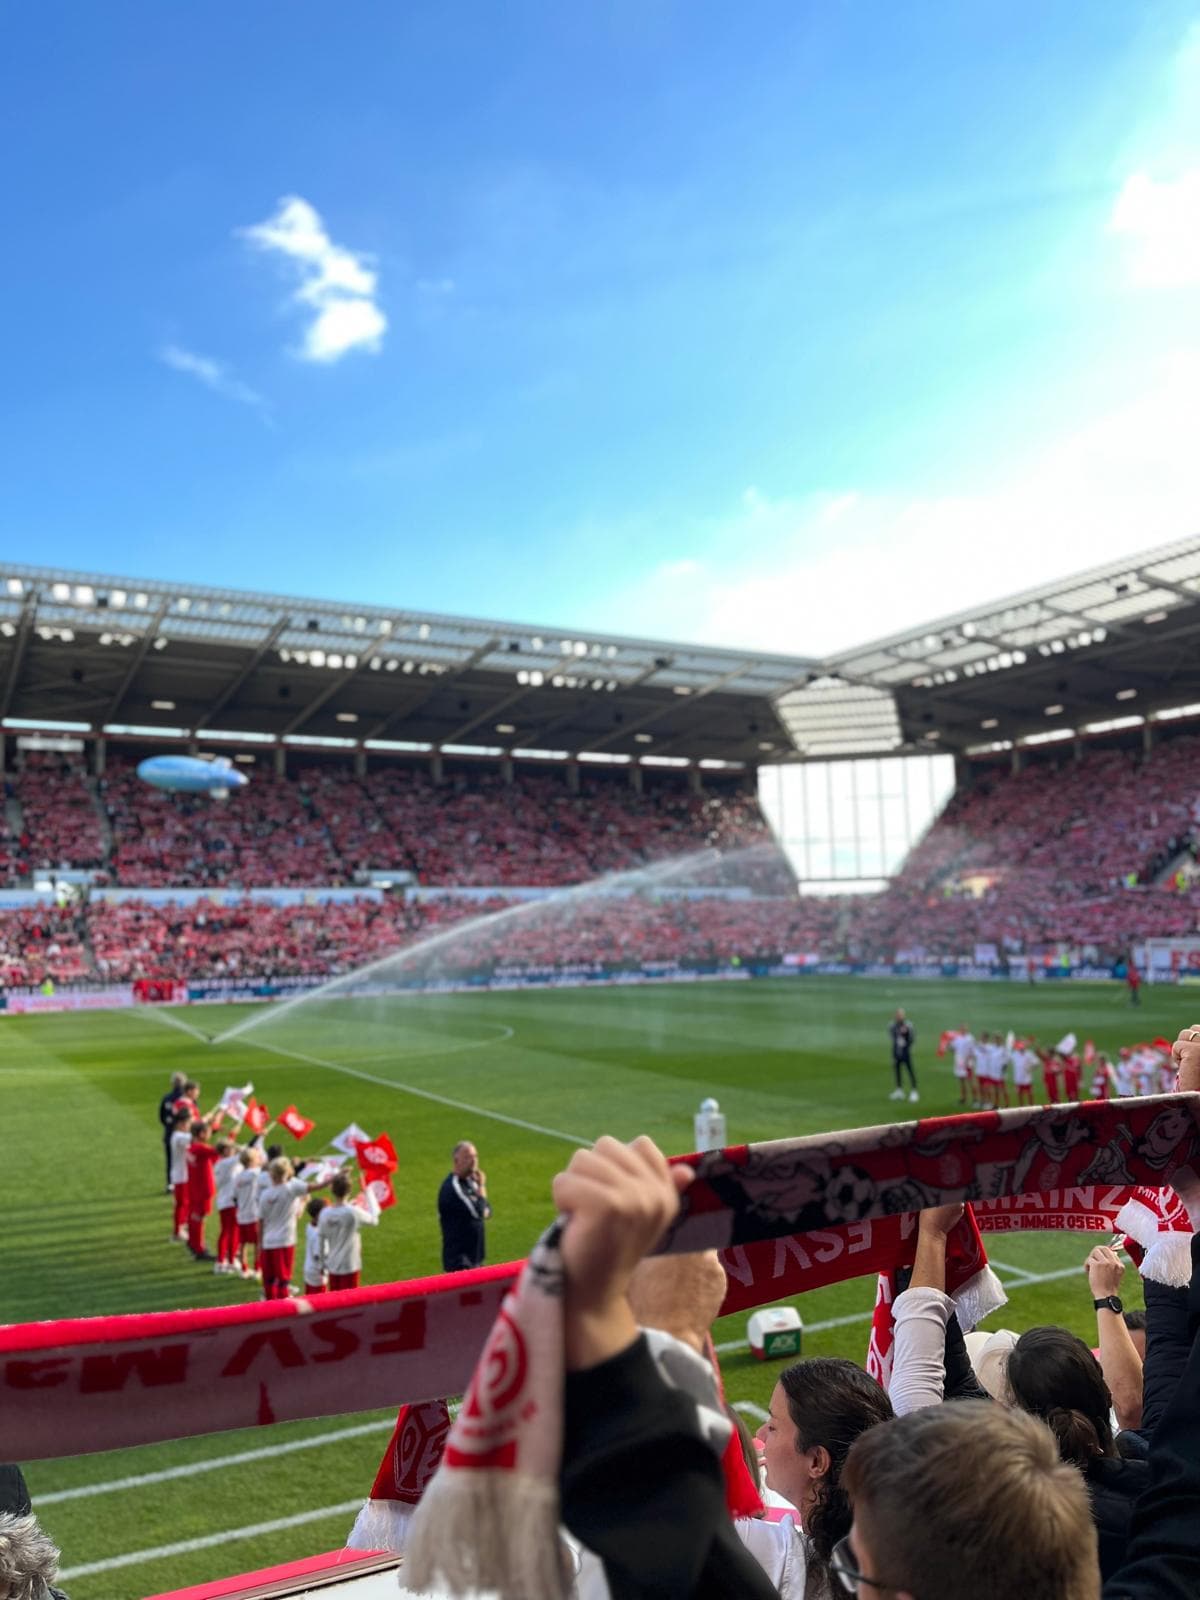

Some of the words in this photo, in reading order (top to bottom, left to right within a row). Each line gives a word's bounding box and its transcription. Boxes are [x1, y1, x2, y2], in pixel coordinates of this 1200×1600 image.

[1020, 1214, 1065, 1230] IMMER
[1066, 1214, 1106, 1231] 05ER
[220, 1299, 427, 1378] FSV
